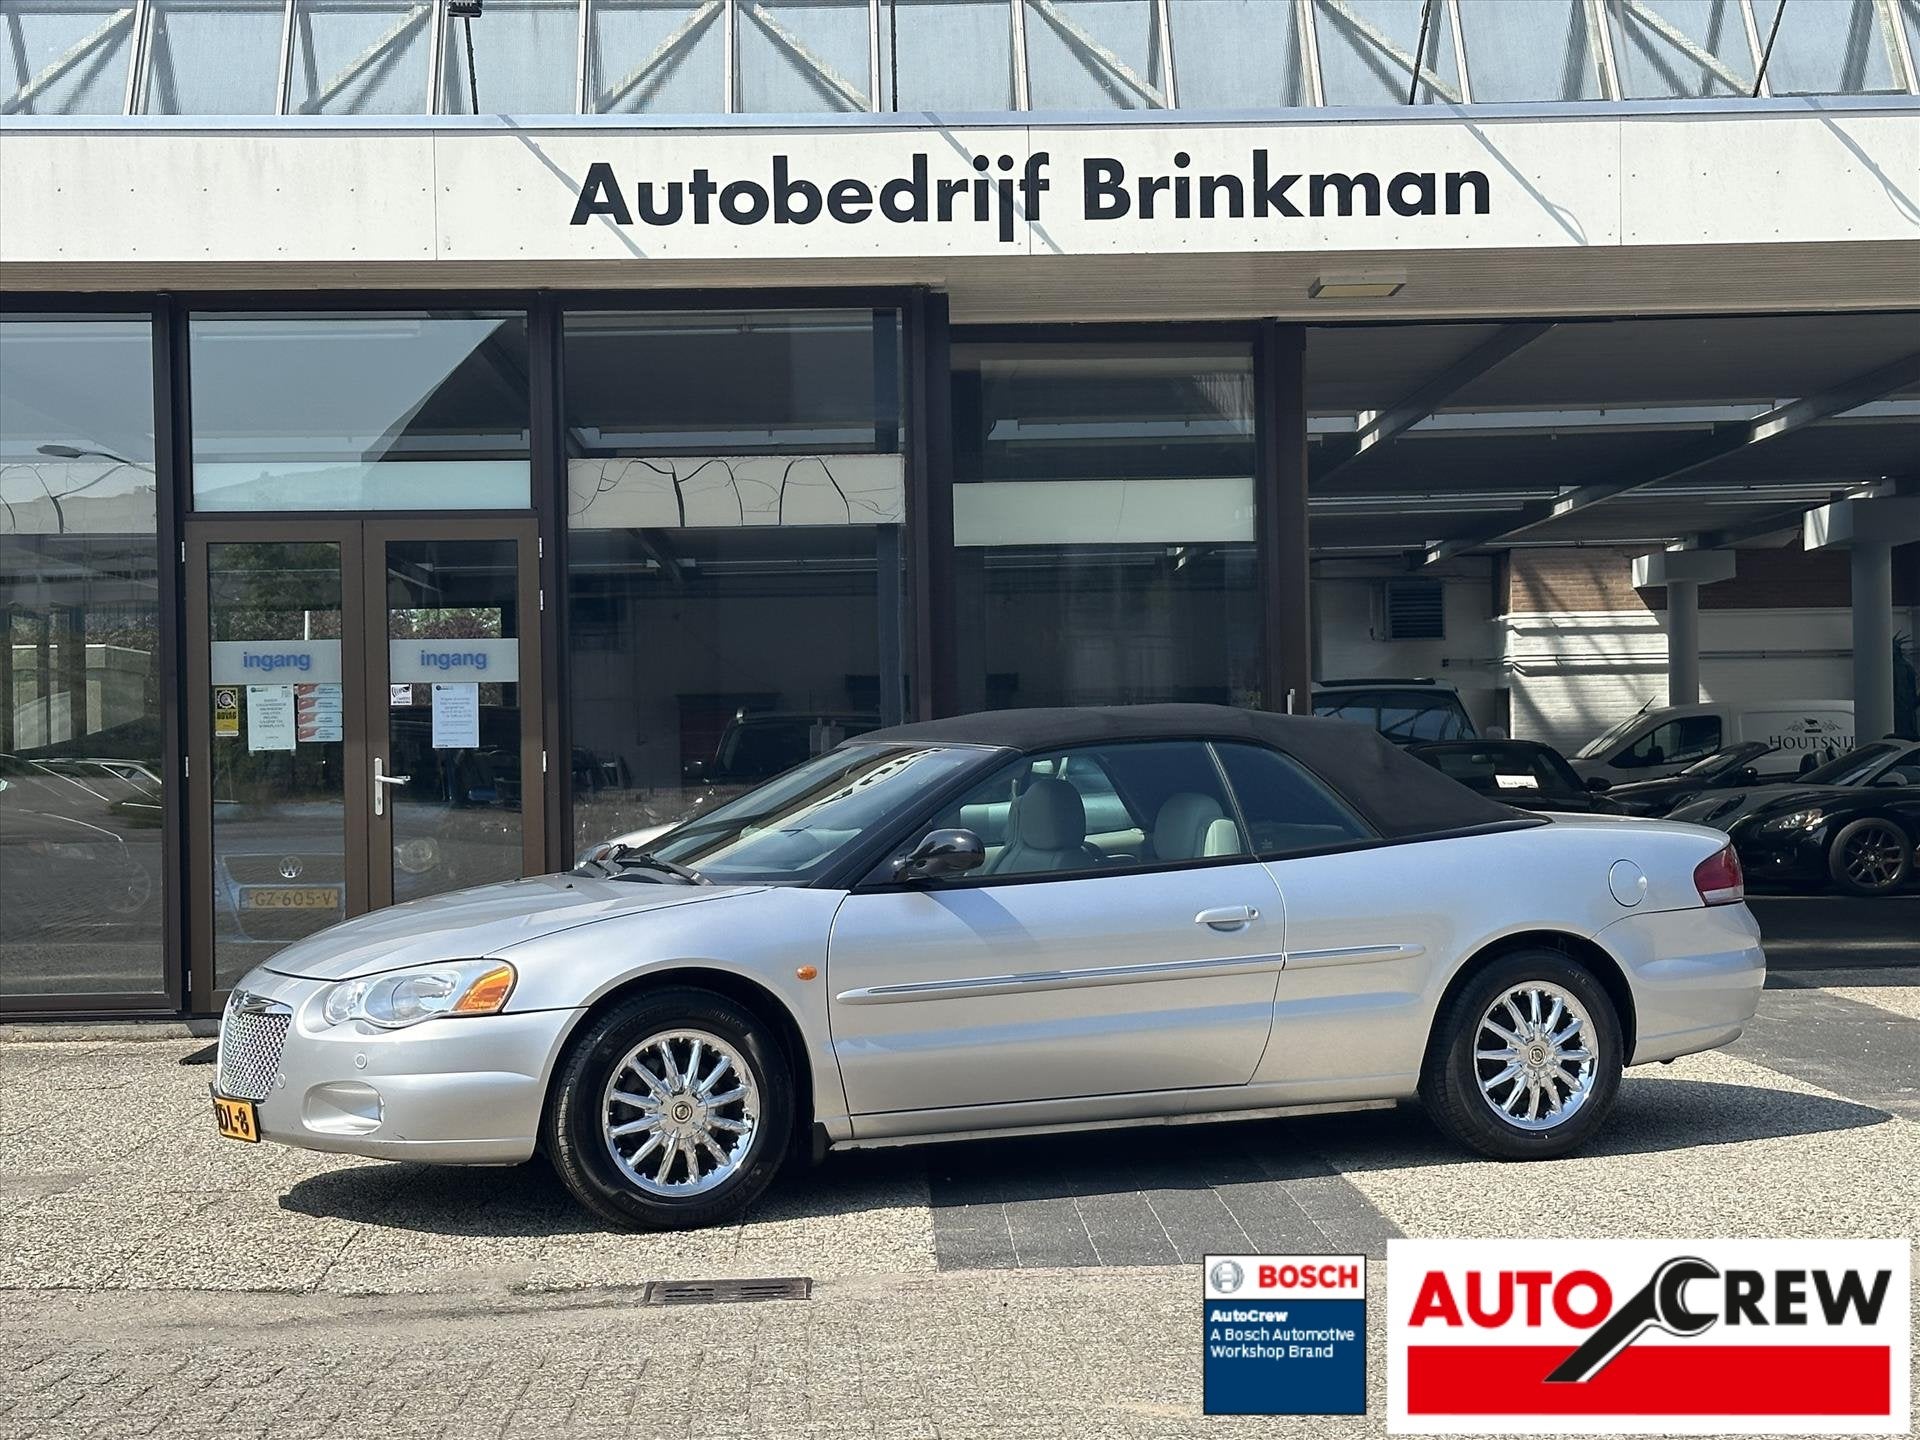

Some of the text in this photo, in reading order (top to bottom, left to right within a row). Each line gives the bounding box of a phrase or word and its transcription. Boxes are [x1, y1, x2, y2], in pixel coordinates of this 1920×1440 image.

[570, 149, 1490, 242] Autobedrijf Brinkman
[243, 651, 312, 672] ingang
[420, 649, 487, 670] ingang
[1769, 736, 1854, 749] HOUTSNI
